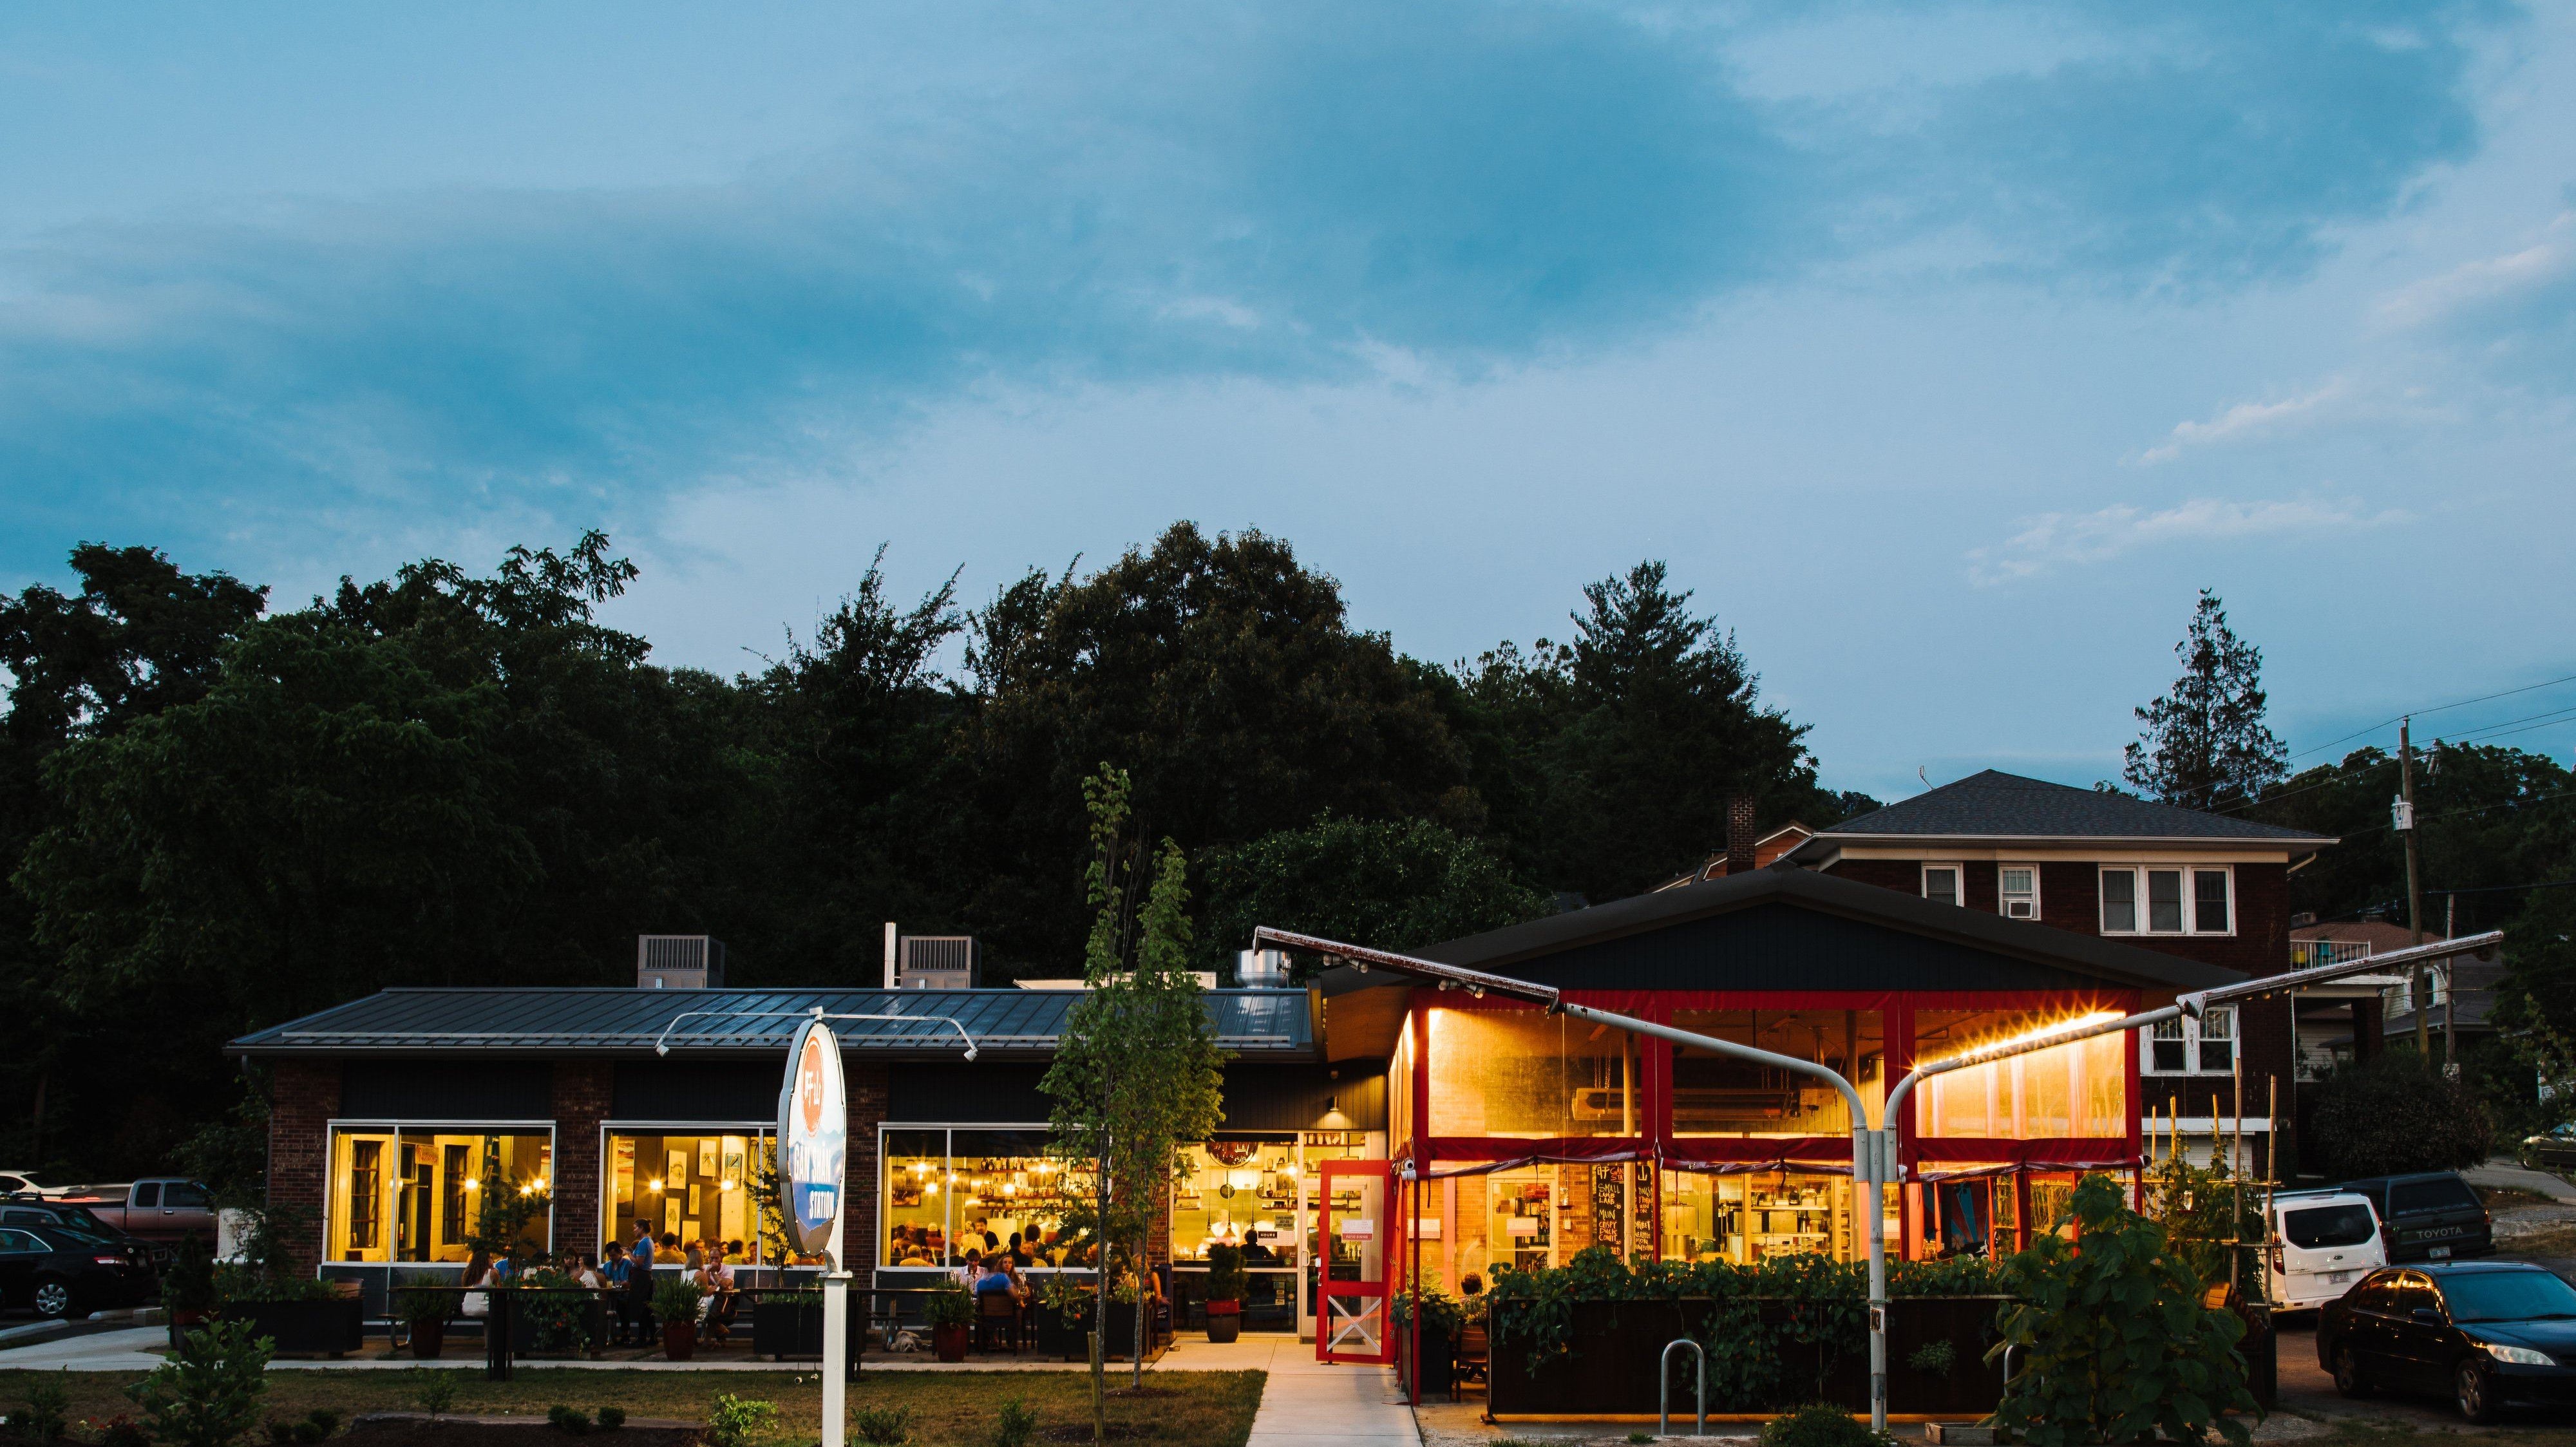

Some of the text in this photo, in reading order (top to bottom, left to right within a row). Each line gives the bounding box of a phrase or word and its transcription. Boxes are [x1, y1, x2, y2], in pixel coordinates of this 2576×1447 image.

[1598, 1184, 1620, 1193] SMALL
[809, 1189, 835, 1219] STATION
[2416, 1226, 2463, 1239] TOYOTA
